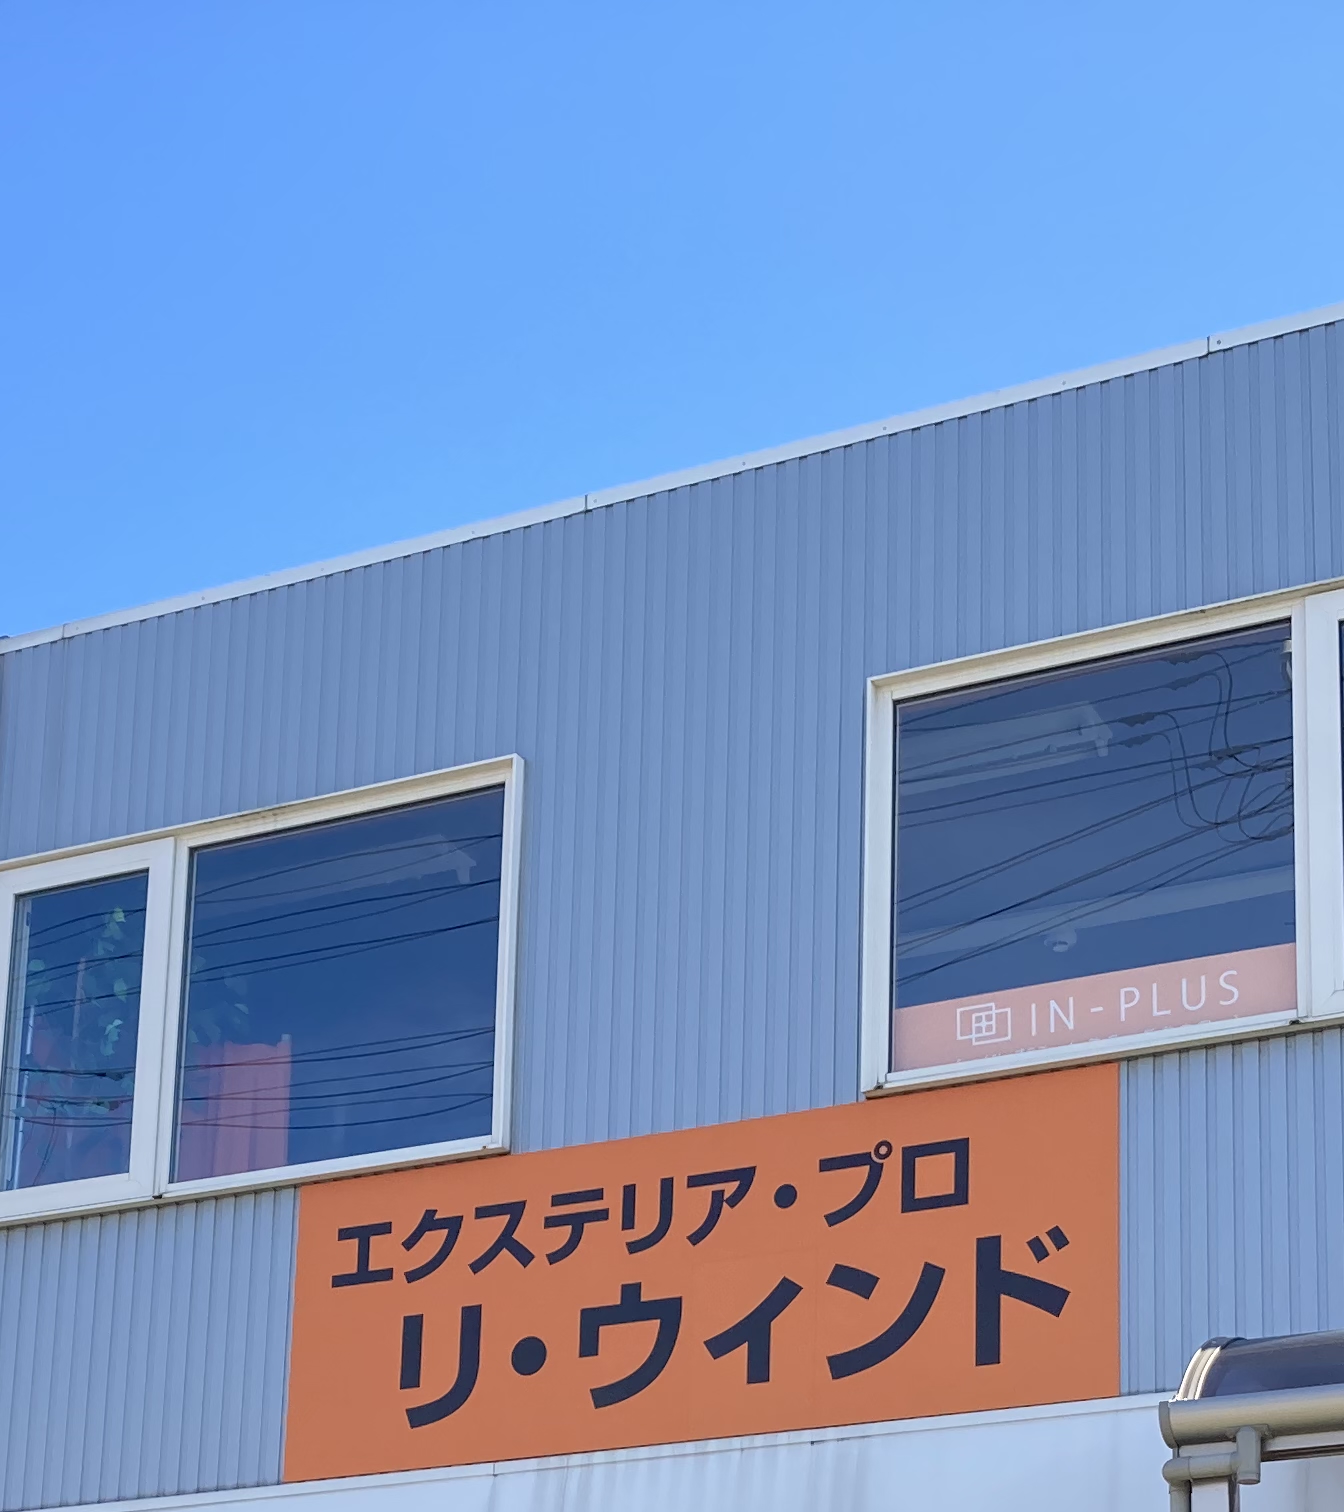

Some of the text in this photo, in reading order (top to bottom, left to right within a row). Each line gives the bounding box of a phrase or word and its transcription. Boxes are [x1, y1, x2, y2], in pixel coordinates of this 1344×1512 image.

[330, 1137, 971, 1289] エクステリア・プロ
[398, 1225, 1071, 1430] リ・ウィンド
